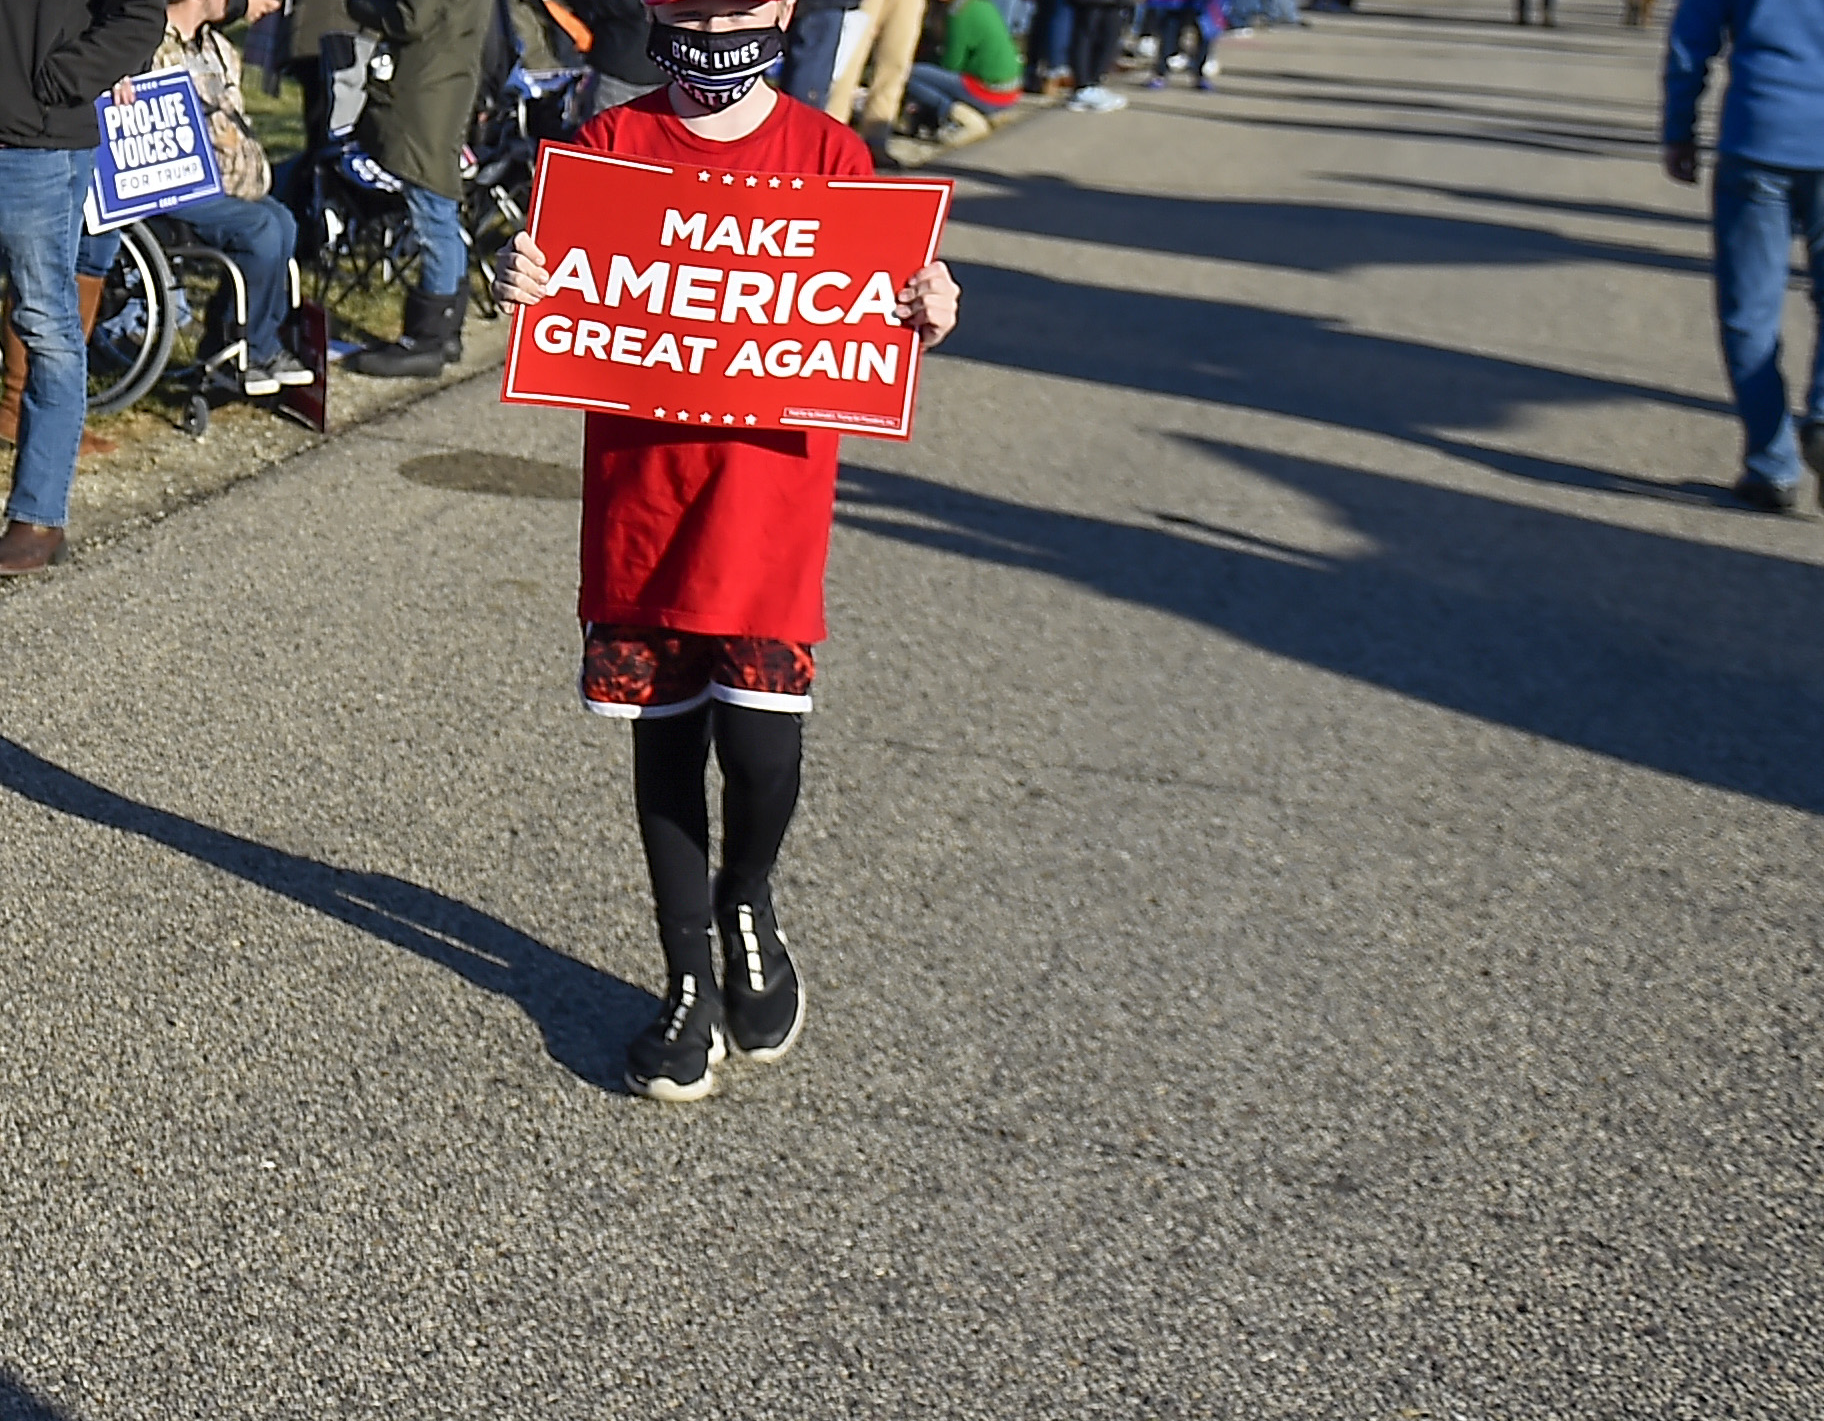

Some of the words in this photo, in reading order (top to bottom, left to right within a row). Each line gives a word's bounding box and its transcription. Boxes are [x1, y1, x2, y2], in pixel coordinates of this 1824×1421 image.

[672, 41, 709, 69] BLUE
[714, 42, 759, 69] LIVES
[104, 92, 190, 140] PRO-LIFE
[110, 129, 179, 170] VOICES
[120, 174, 150, 192] FOR
[157, 163, 198, 180] TRUMP
[660, 209, 821, 257] MAKE
[546, 248, 903, 326] AMERICA
[533, 315, 717, 375] GREAT
[725, 339, 899, 385] AGAIN
